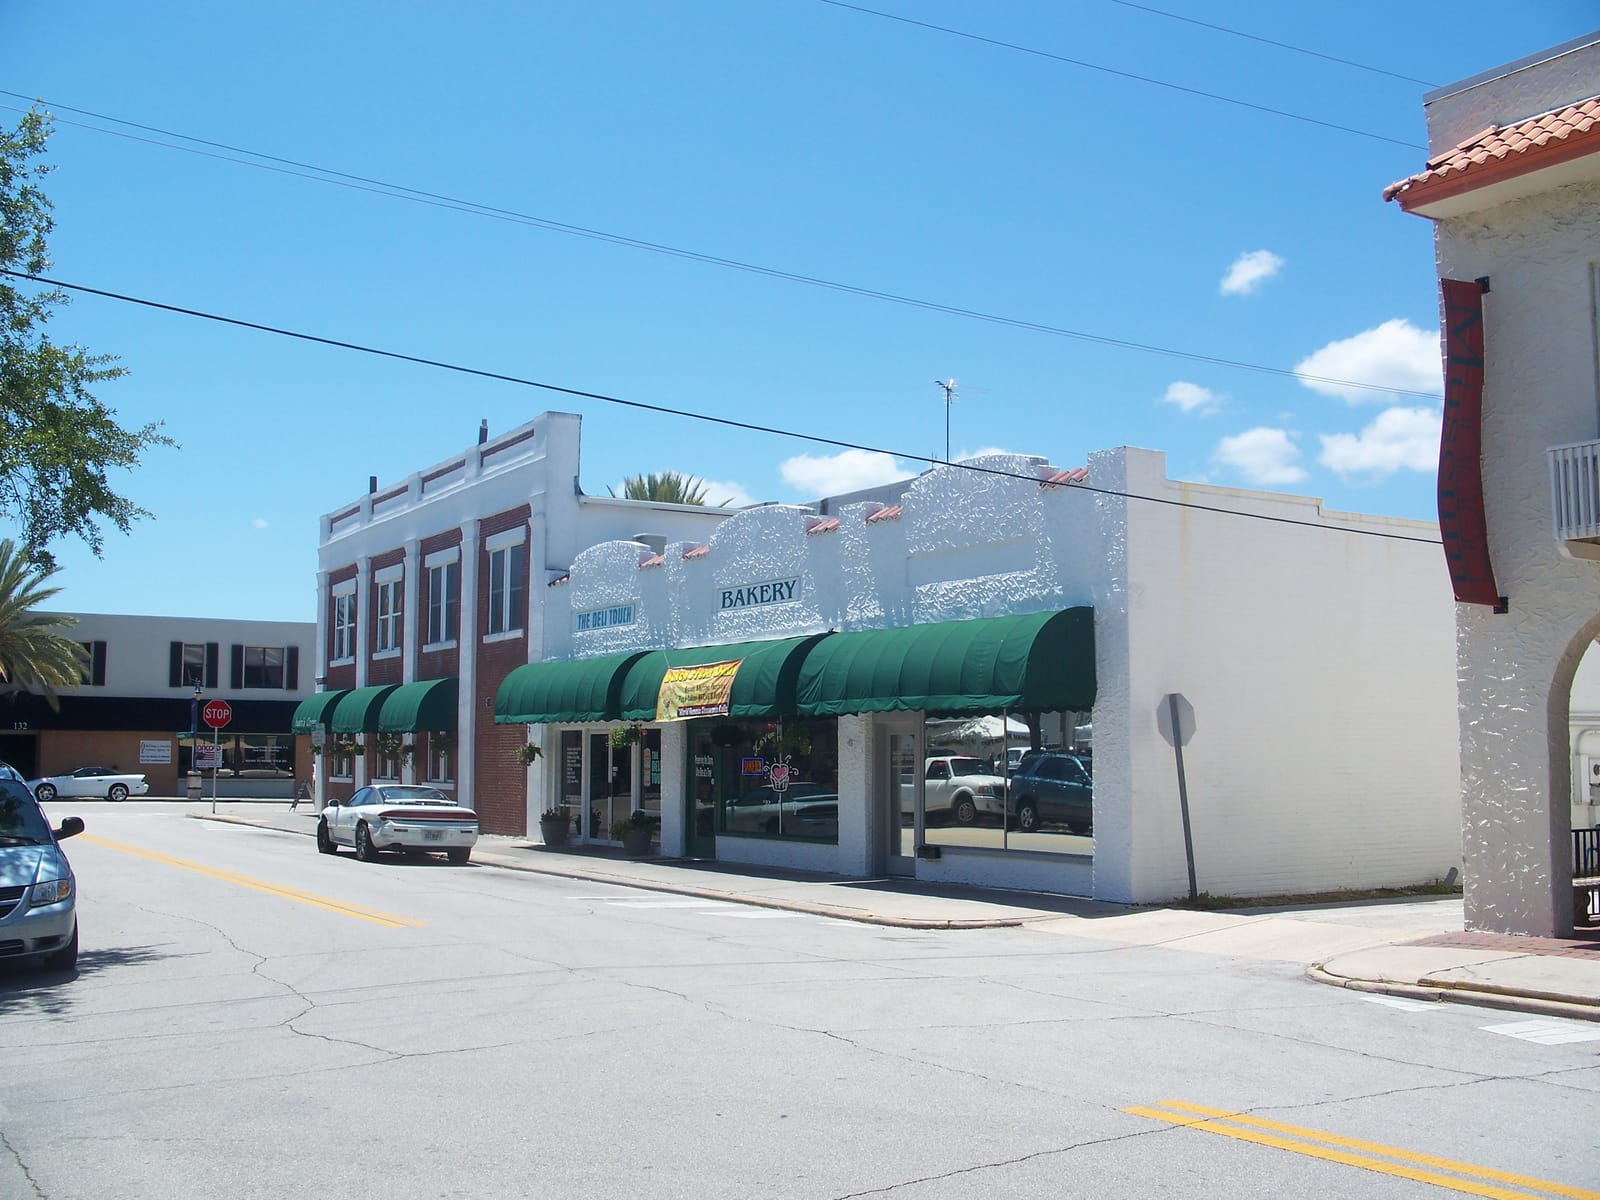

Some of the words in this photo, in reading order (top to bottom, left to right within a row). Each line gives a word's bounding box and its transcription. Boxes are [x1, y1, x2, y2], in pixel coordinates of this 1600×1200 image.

[721, 580, 797, 609] BAKERY
[578, 612, 591, 629] THE
[592, 610, 608, 627] DELI
[609, 606, 632, 625] TOUCH
[205, 708, 230, 719] STOP
[14, 721, 28, 730] 132
